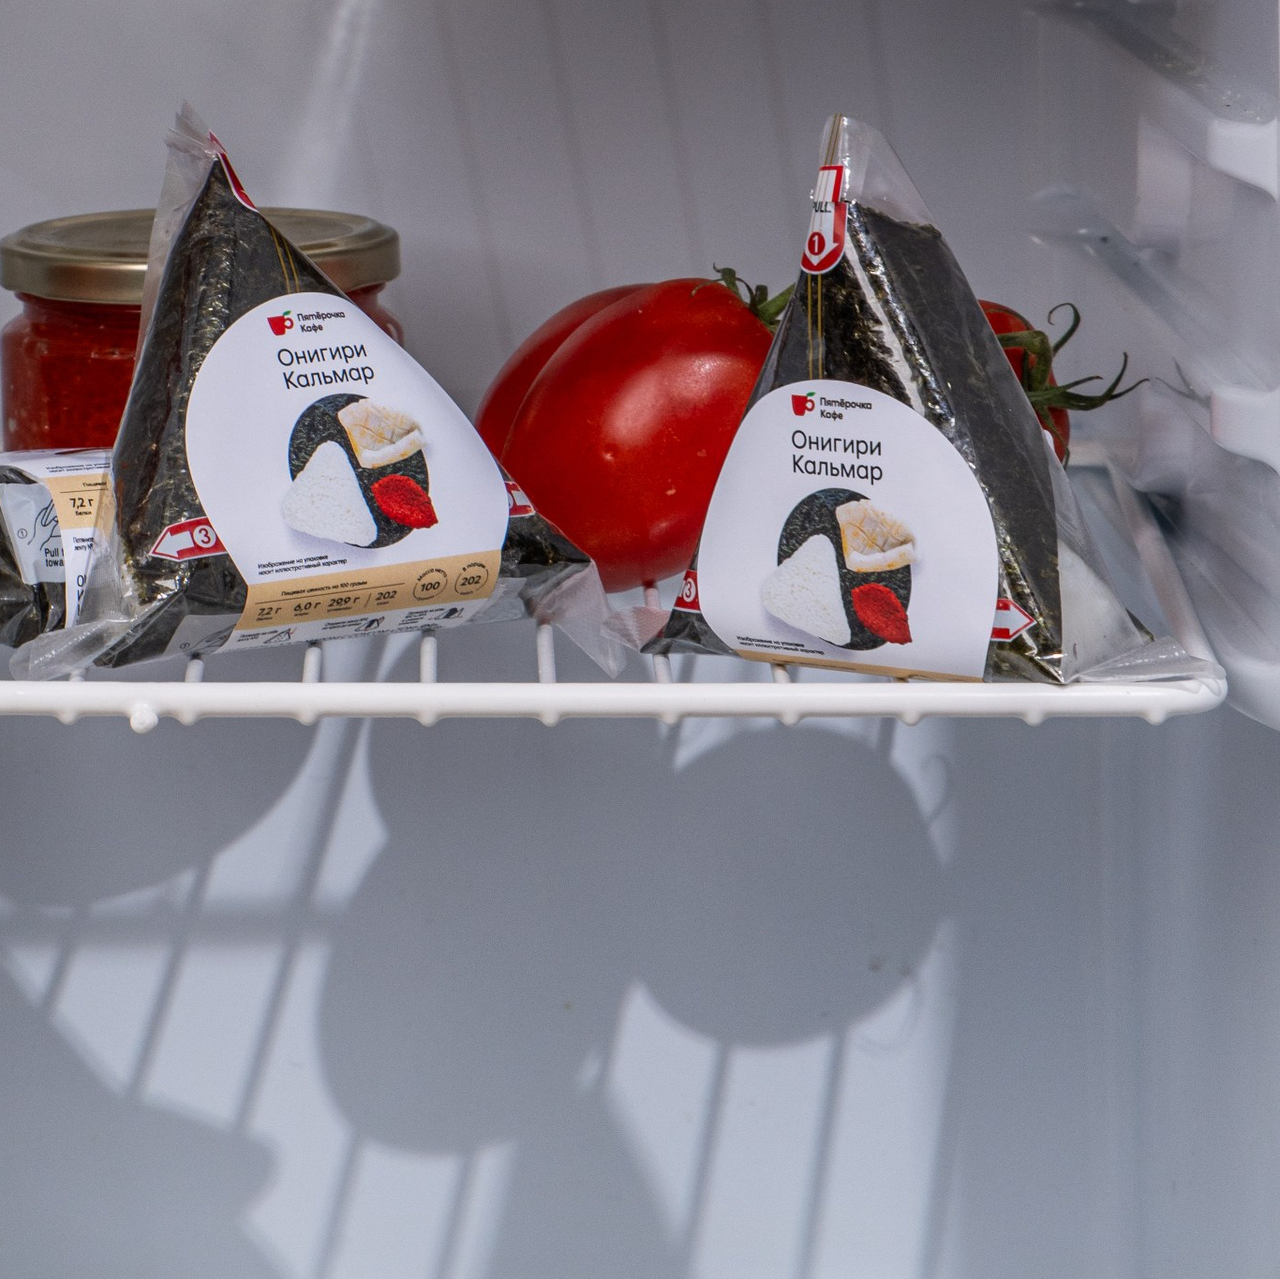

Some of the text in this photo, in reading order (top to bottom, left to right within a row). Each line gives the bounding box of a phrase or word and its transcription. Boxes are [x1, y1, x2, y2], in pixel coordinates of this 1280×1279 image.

[296, 311, 345, 322] Пятёрочка
[300, 324, 323, 333] Кафе
[278, 344, 367, 366] Онигири
[283, 366, 374, 390] Кальмар
[820, 397, 872, 410] Пятёрочка
[820, 410, 843, 421] Кафе
[792, 430, 882, 459] Онигири
[792, 454, 883, 485] Кальмар
[69, 498, 86, 509] 7,2
[198, 528, 211, 544] 3
[44, 548, 59, 557] Pull
[460, 575, 482, 586] 202
[421, 581, 440, 592] 100
[375, 590, 397, 601] 202
